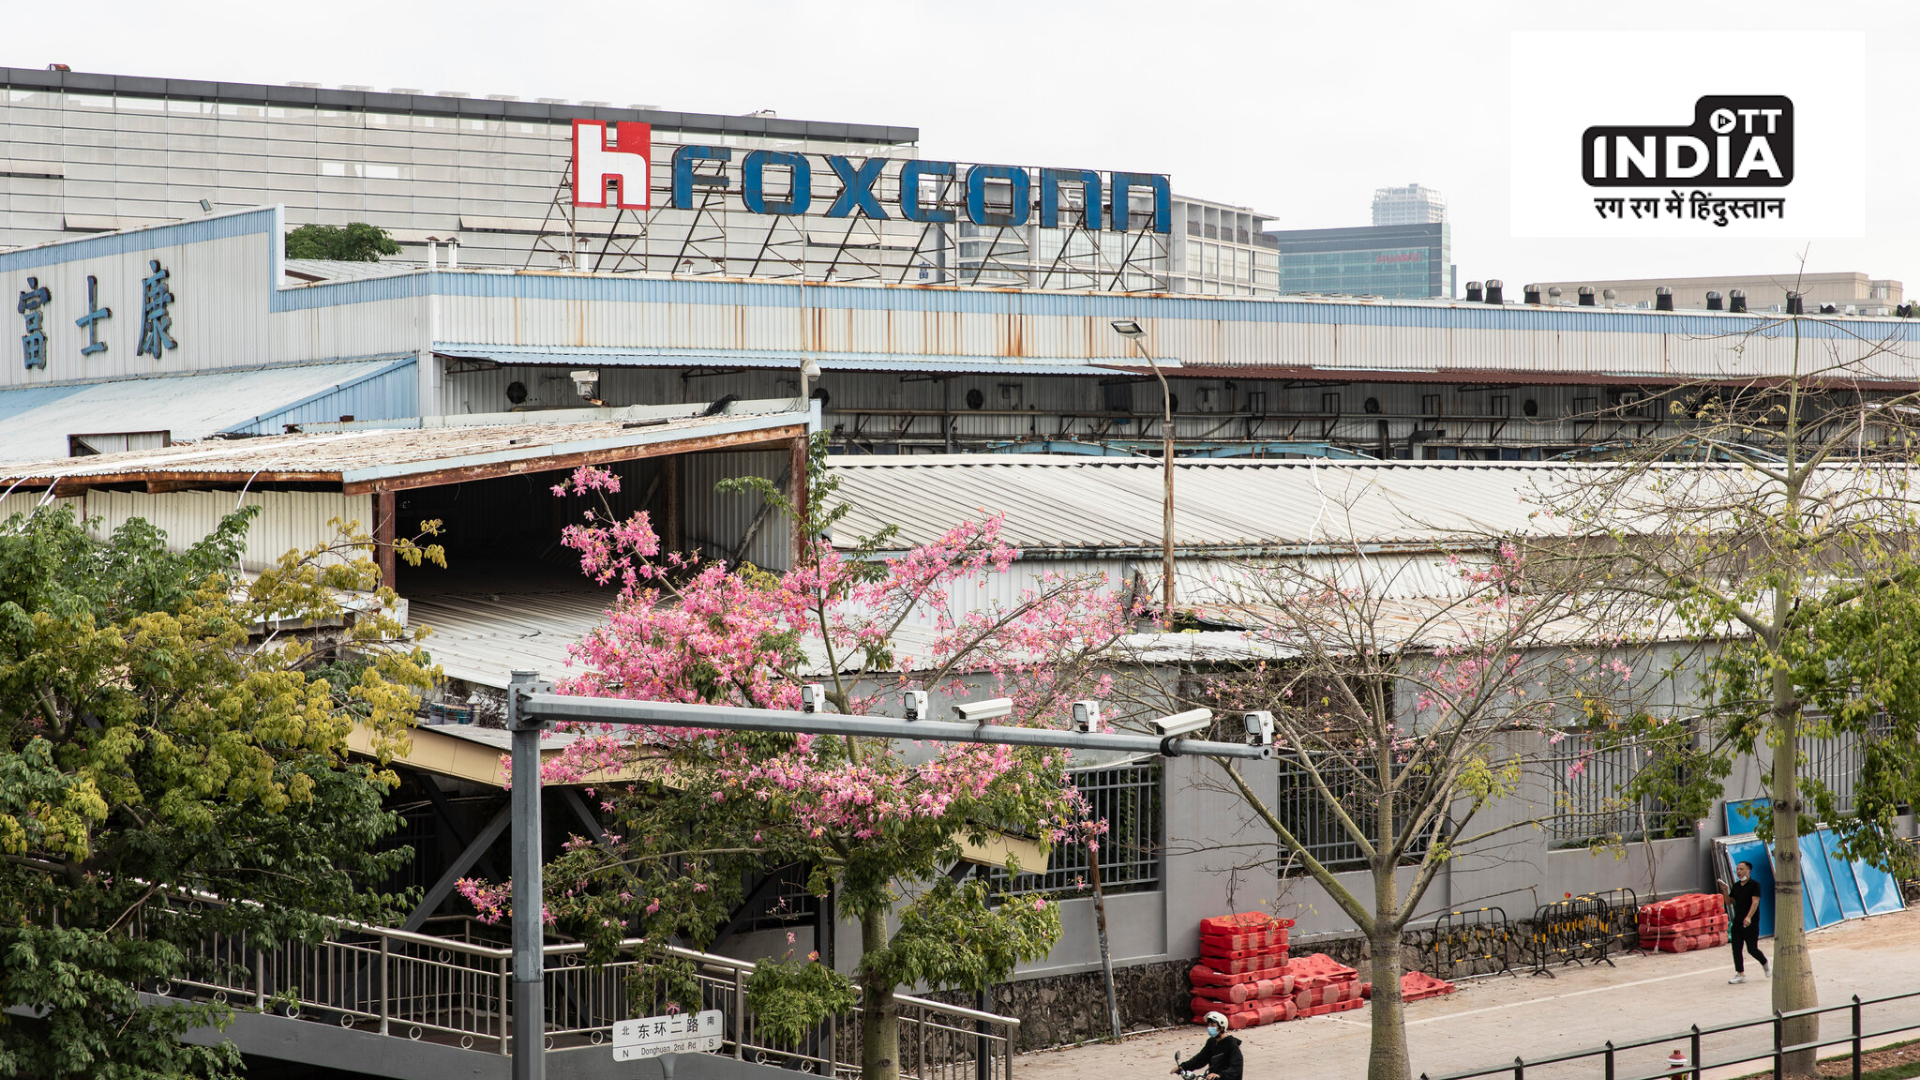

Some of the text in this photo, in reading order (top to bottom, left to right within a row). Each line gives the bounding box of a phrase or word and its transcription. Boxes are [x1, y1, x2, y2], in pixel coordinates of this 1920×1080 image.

[1376, 252, 1422, 264] HUAWEI
[18, 260, 178, 370] 富士康
[621, 1016, 715, 1039] 北 东环二路 南
[622, 1038, 715, 1058] N Donghuan 2nd Rd S
